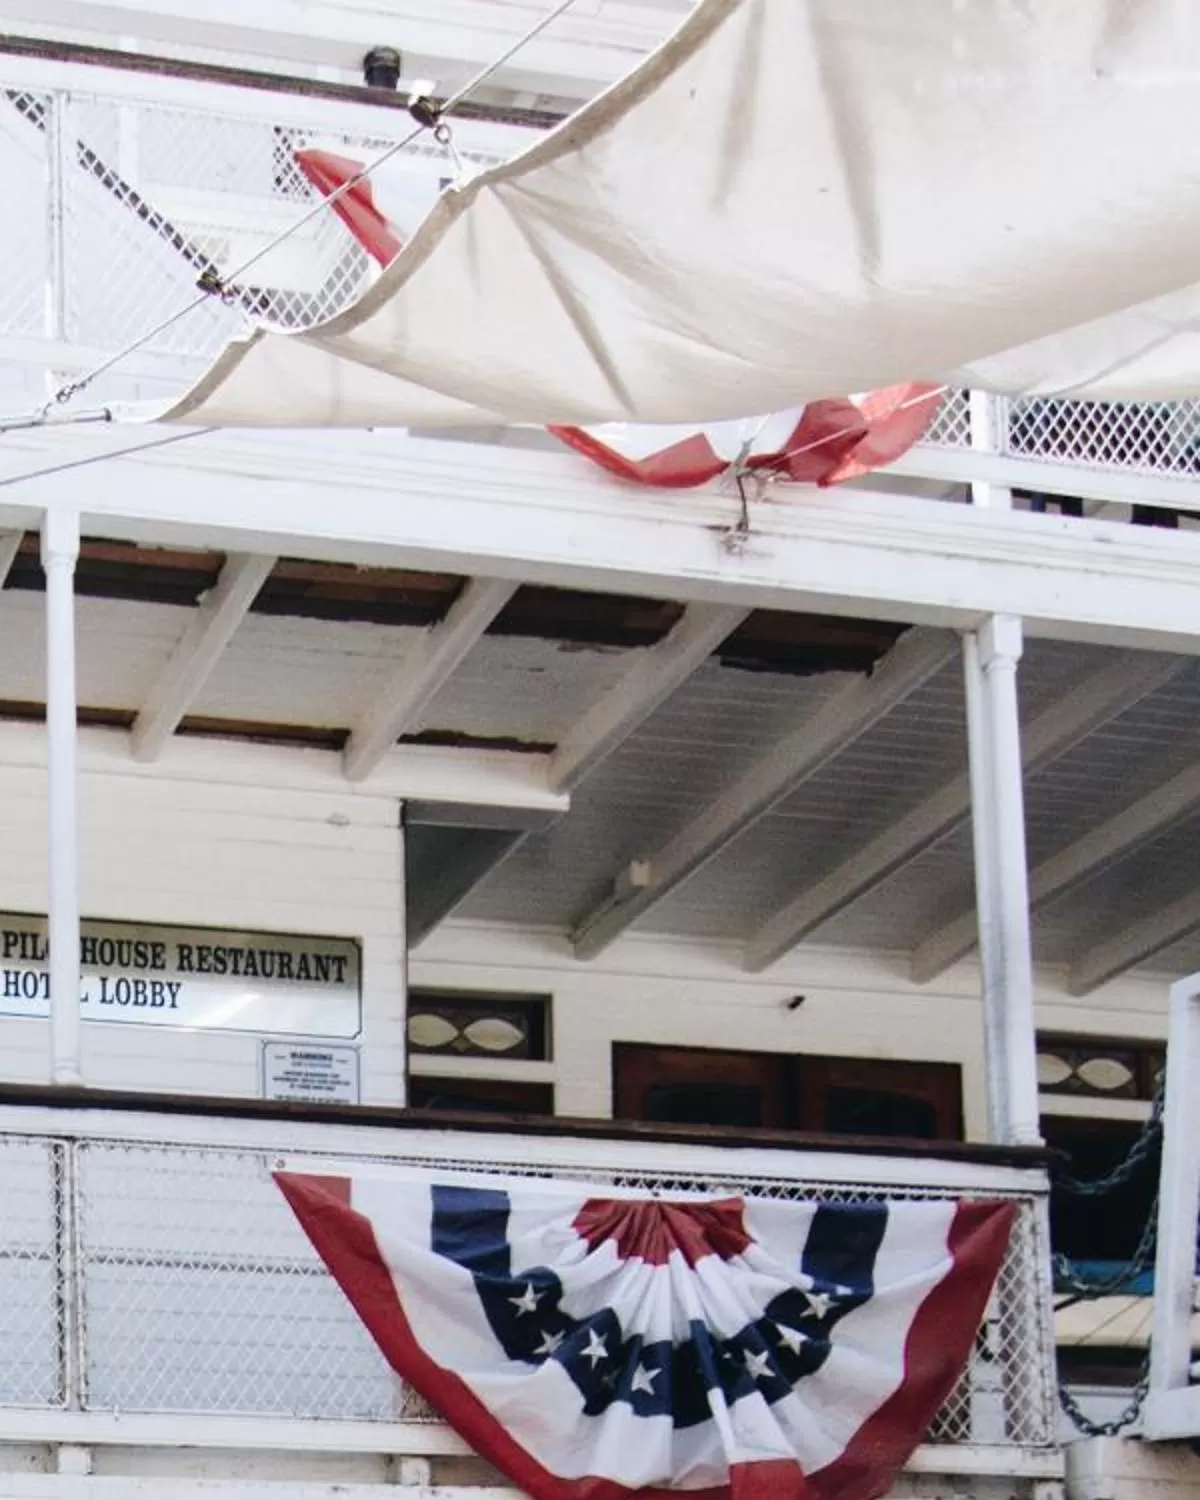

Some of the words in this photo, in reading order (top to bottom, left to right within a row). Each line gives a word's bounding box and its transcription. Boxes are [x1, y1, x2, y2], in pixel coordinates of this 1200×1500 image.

[2, 930, 166, 970] PILHOUSE
[177, 946, 348, 983] RESTAURANT
[3, 969, 89, 1003] HOT
[99, 975, 182, 1009] LOBBY
